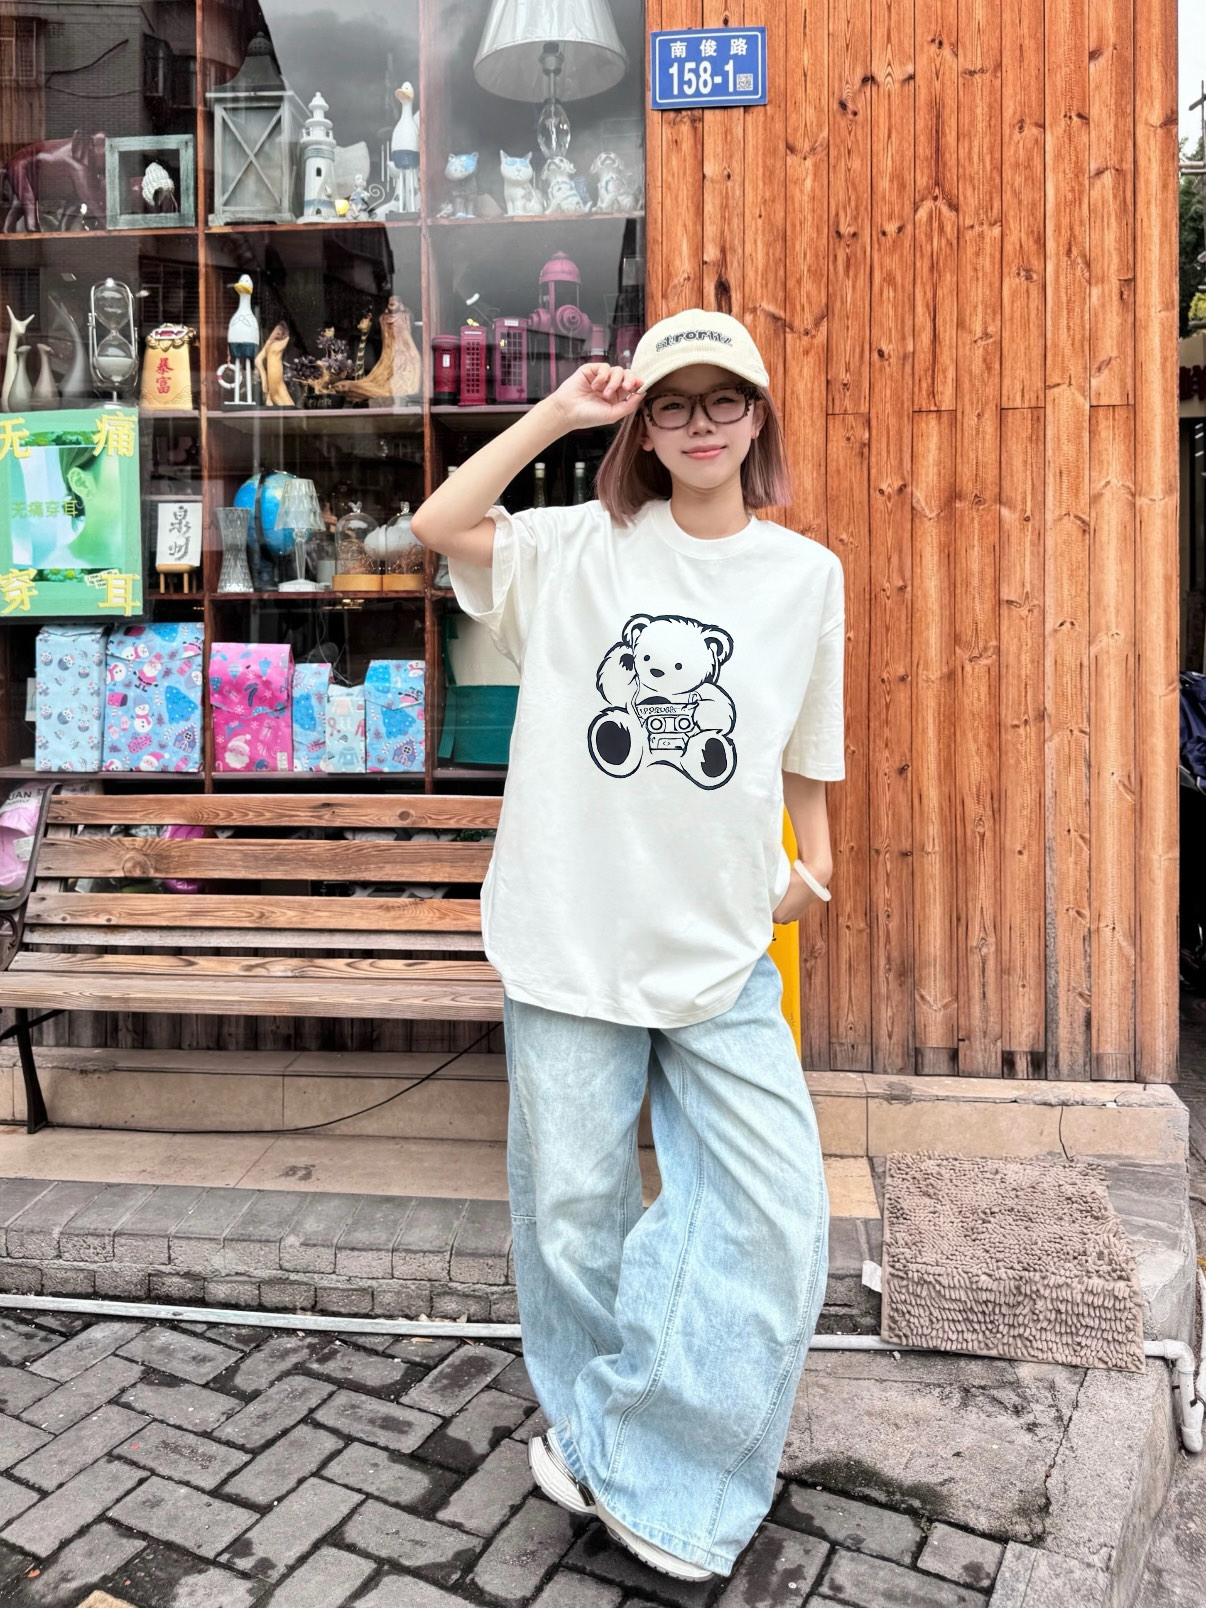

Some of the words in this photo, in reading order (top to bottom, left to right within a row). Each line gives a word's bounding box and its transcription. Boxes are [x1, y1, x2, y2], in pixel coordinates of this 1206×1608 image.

[670, 37, 748, 58] 南俊路
[668, 59, 735, 96] 158-1
[156, 357, 174, 394] 暴富
[11, 499, 78, 519] 无痛穿耳
